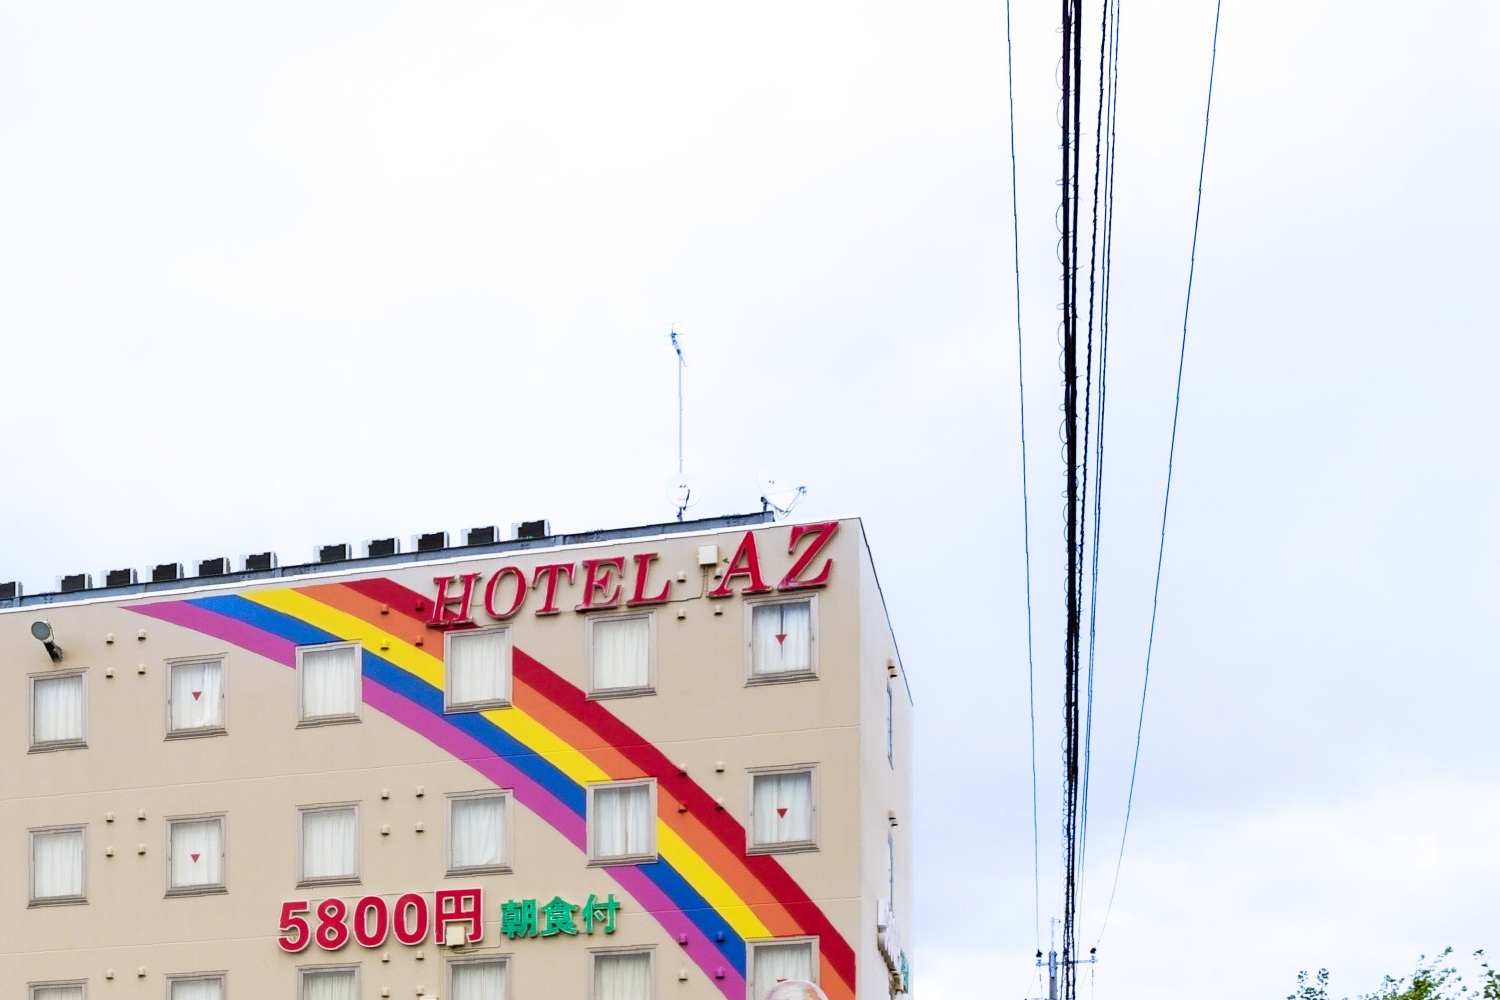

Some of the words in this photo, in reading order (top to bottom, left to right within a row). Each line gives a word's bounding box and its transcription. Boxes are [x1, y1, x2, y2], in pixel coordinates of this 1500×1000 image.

[426, 552, 672, 630] HOTEL
[708, 521, 840, 599] AZ
[277, 887, 484, 953] 5800円
[500, 893, 622, 940] 朝食付
